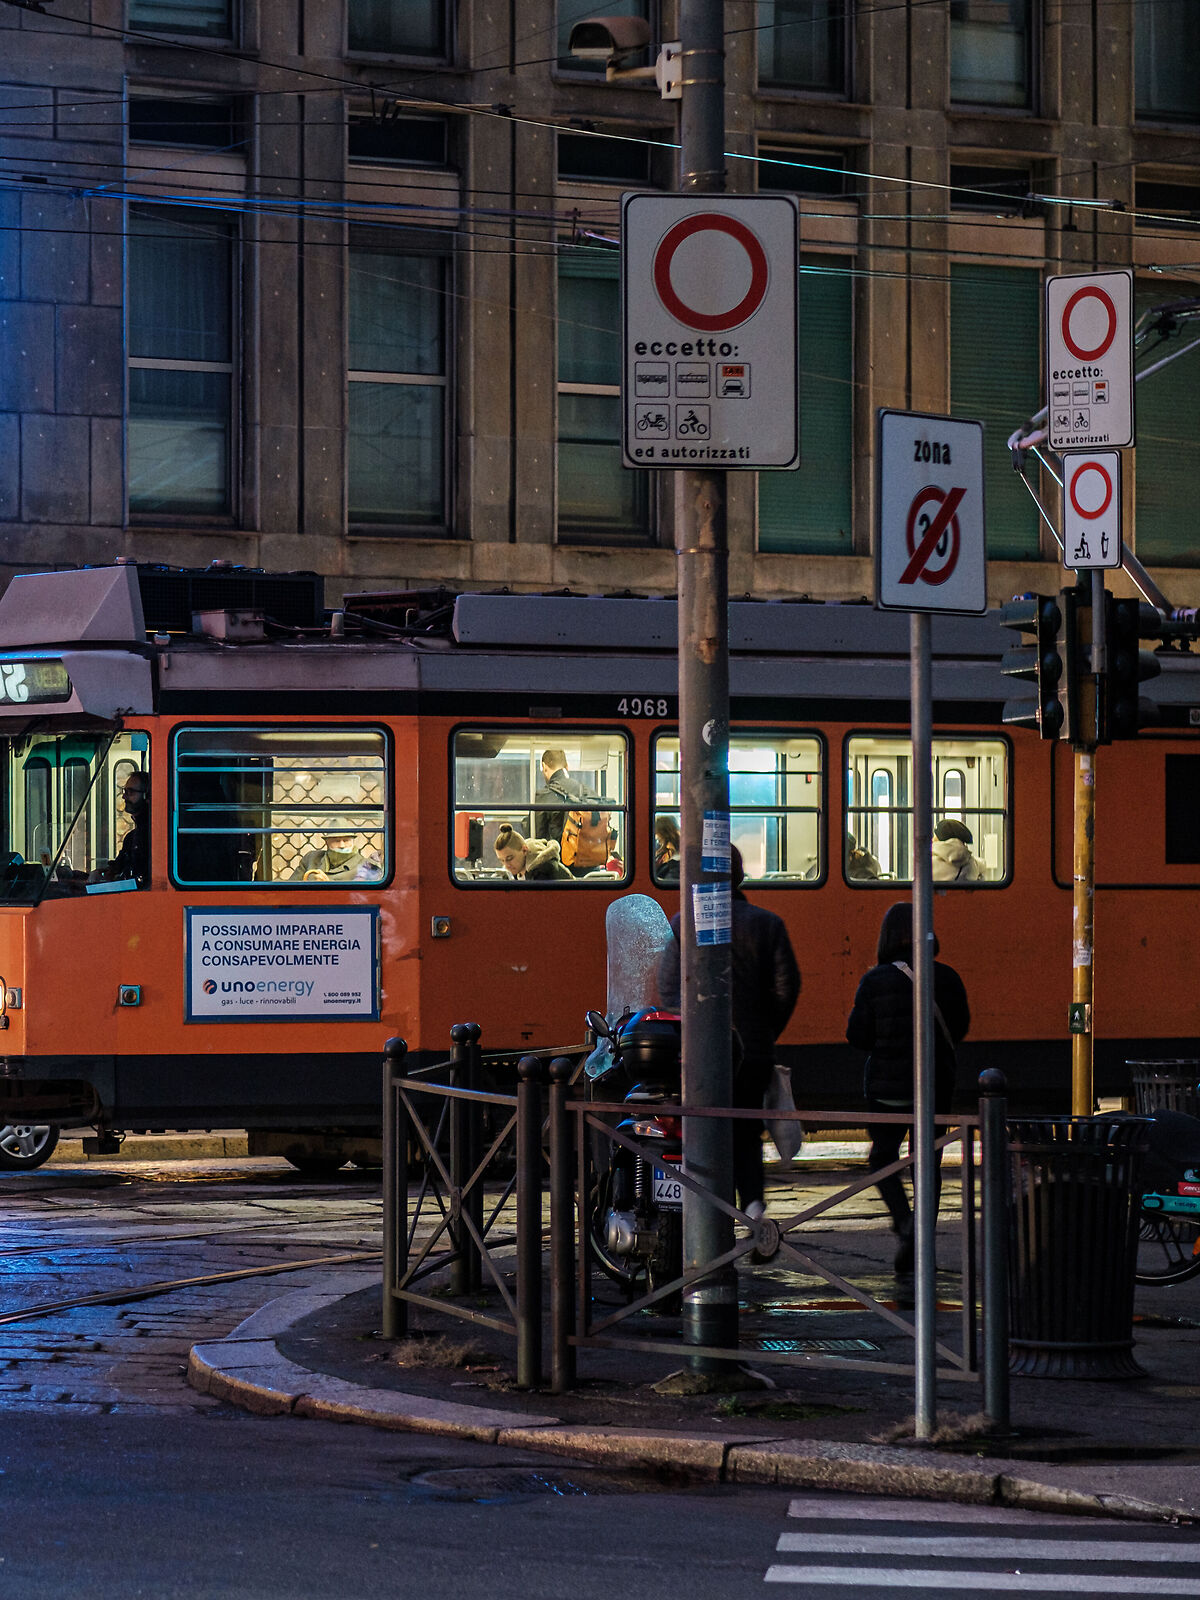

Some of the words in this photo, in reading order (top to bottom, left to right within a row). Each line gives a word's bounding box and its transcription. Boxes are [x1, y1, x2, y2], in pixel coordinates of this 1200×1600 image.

[635, 338, 739, 357] eccetto:
[1053, 366, 1103, 379] eccetto:
[1066, 433, 1109, 443] autorizzati
[635, 446, 654, 458] ed
[661, 446, 750, 459] autorizzati
[914, 440, 951, 465] zona
[202, 925, 272, 936] POSSIAMO
[276, 924, 343, 935] IMPARARE
[201, 940, 211, 951] A
[214, 940, 299, 951] CONSUMARE
[303, 939, 361, 950] ENERGIA
[202, 954, 339, 966] CONSAPEVOLMENTE
[221, 979, 315, 996] unoenergy
[221, 998, 233, 1006] gas
[239, 997, 254, 1005] luce
[260, 997, 297, 1005] rinnovabili
[656, 1183, 681, 1199] 448
